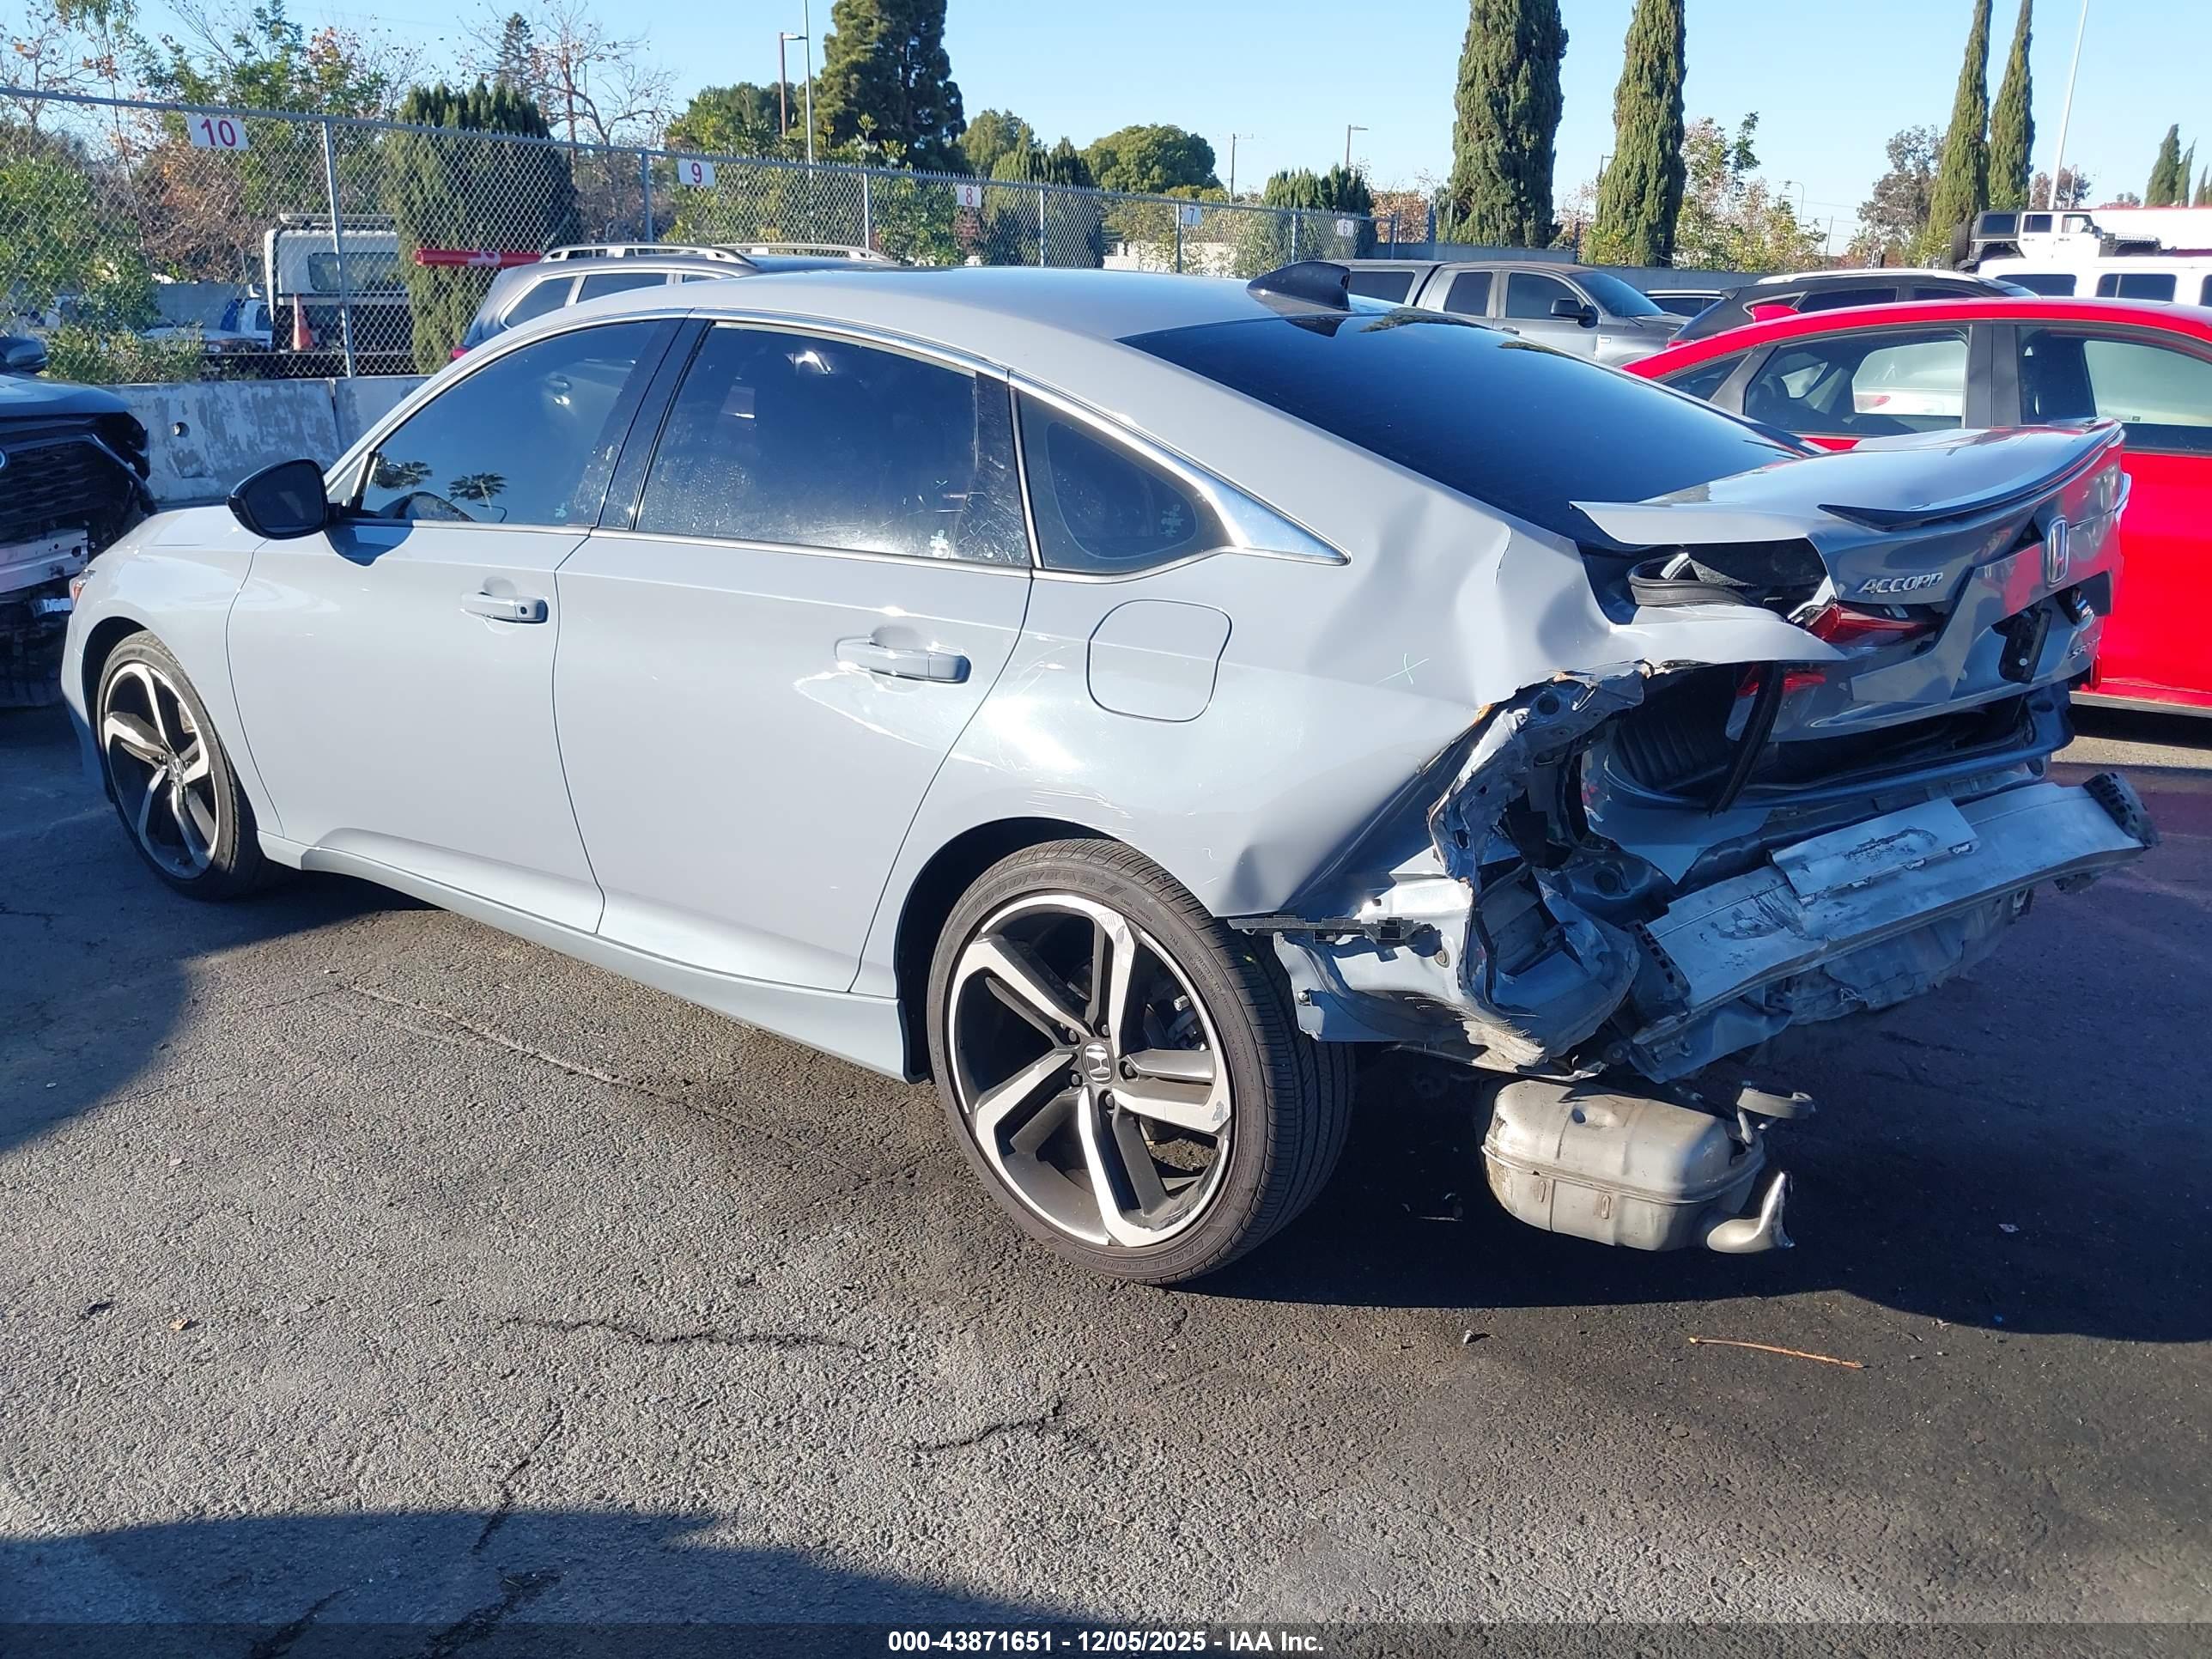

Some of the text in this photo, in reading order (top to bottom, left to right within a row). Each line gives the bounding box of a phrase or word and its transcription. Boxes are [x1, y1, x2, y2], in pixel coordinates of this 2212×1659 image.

[200, 118, 236, 147] 10
[691, 162, 702, 184] 9
[966, 187, 973, 205] 8
[1189, 207, 1195, 223] 7
[1343, 222, 1348, 234] 6
[1856, 572, 1943, 593] ACCORD
